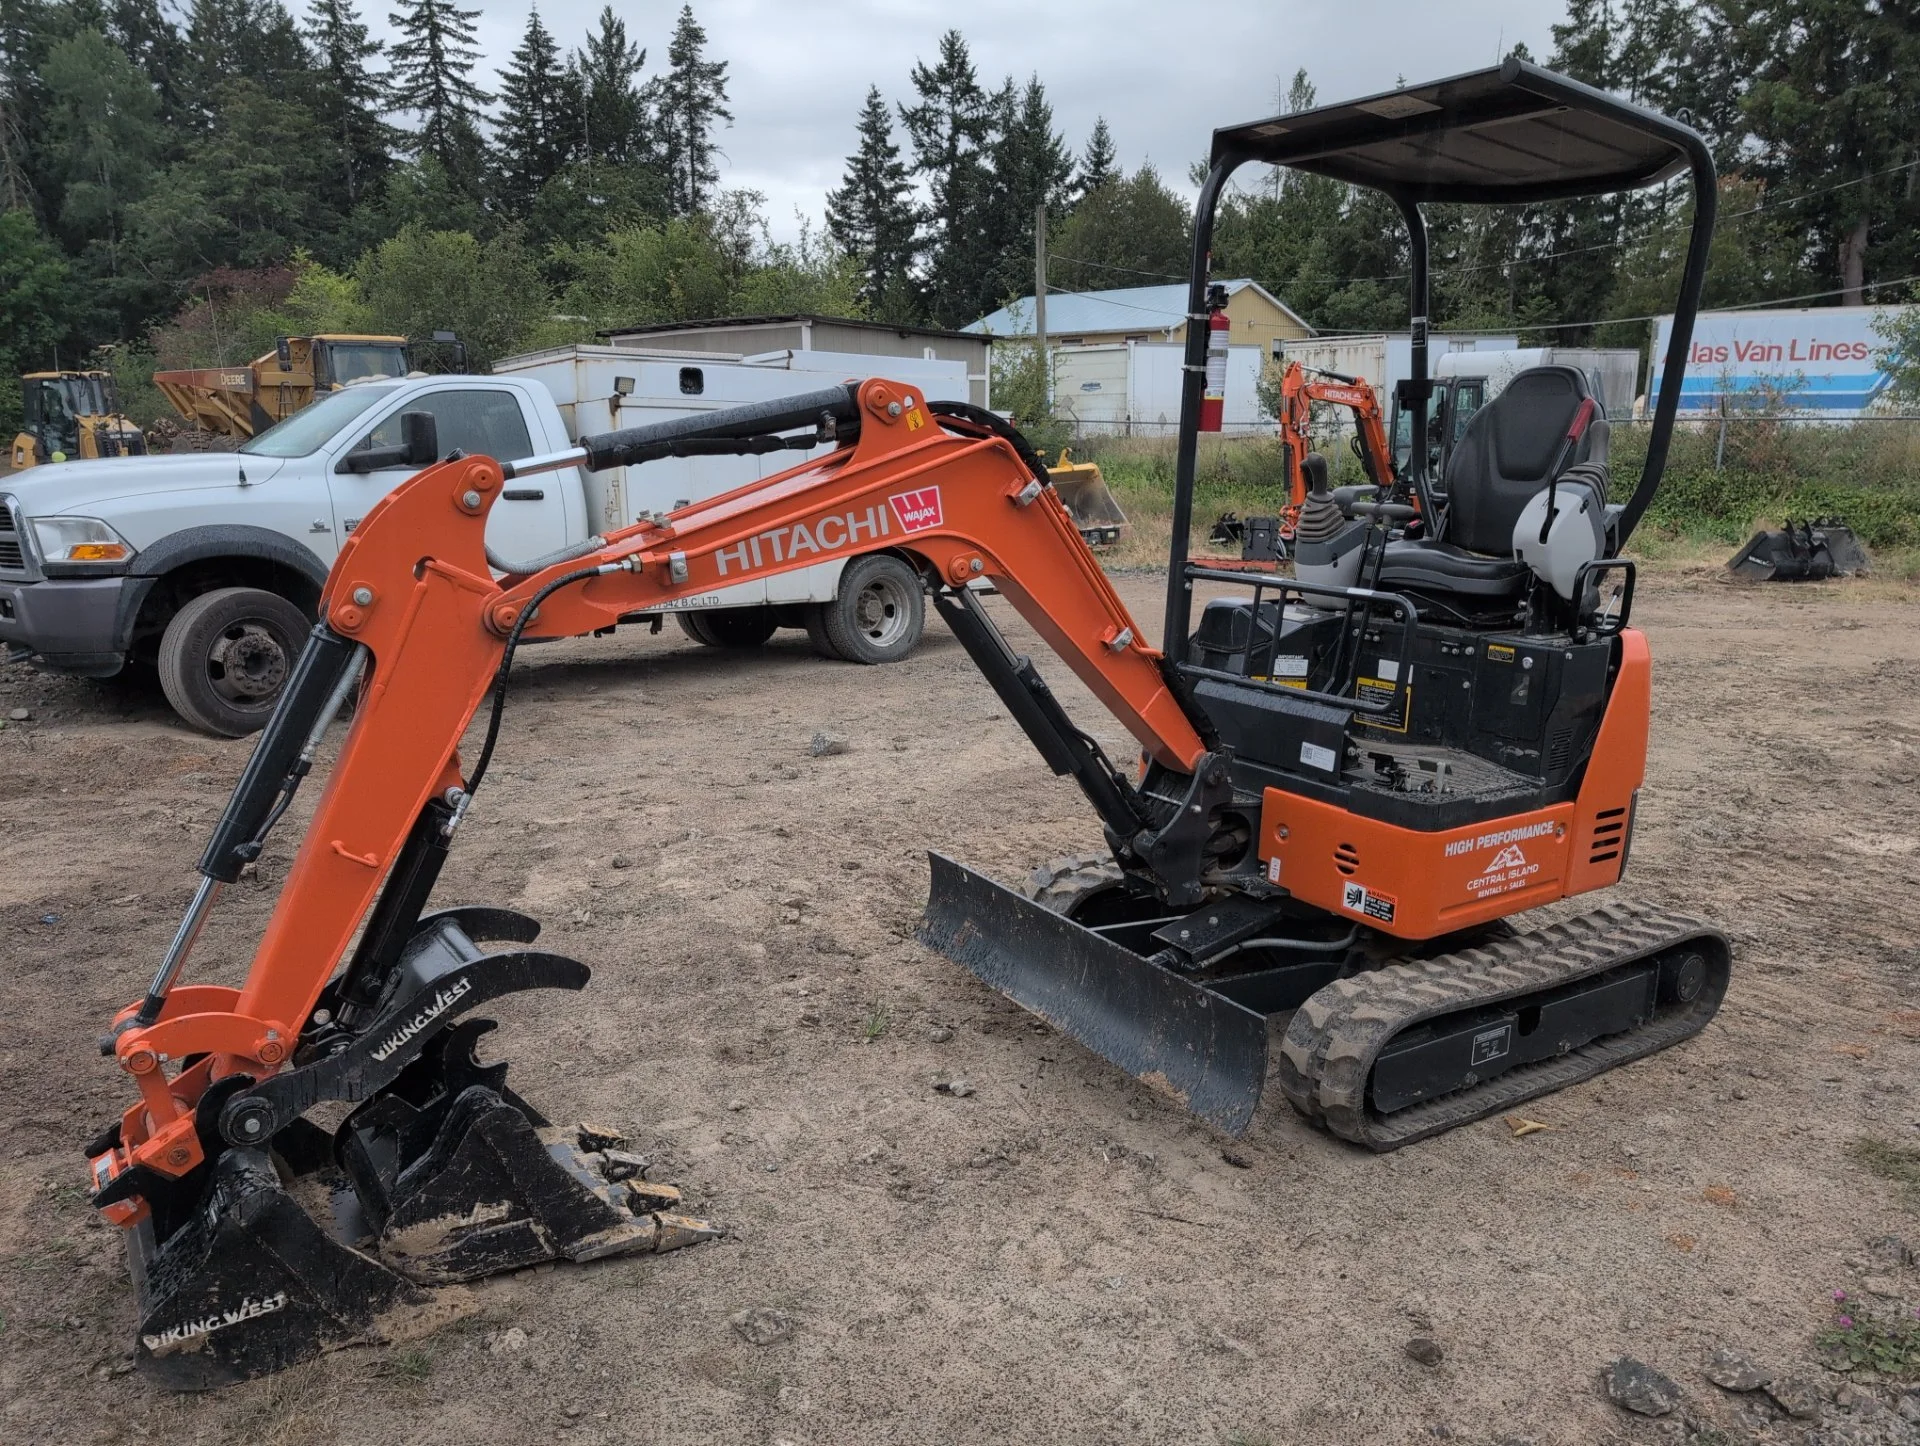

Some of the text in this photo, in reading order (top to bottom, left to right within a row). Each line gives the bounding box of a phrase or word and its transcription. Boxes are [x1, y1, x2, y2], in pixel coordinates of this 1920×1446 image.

[1662, 338, 1868, 364] las Van Lines
[220, 374, 246, 385] DEERE
[1324, 388, 1352, 401] HITACHI
[903, 506, 936, 522] WAJAX
[715, 504, 889, 576] HITACHI
[1445, 821, 1555, 857] HIGH PERFORMANCE
[1466, 863, 1539, 891] CENTRAL ISLAND
[1478, 885, 1502, 898] RENTALS
[1509, 879, 1526, 890] SALES
[1371, 889, 1396, 904] WARNING
[370, 1014, 428, 1061] VIKING
[142, 1316, 221, 1351] VIKING
